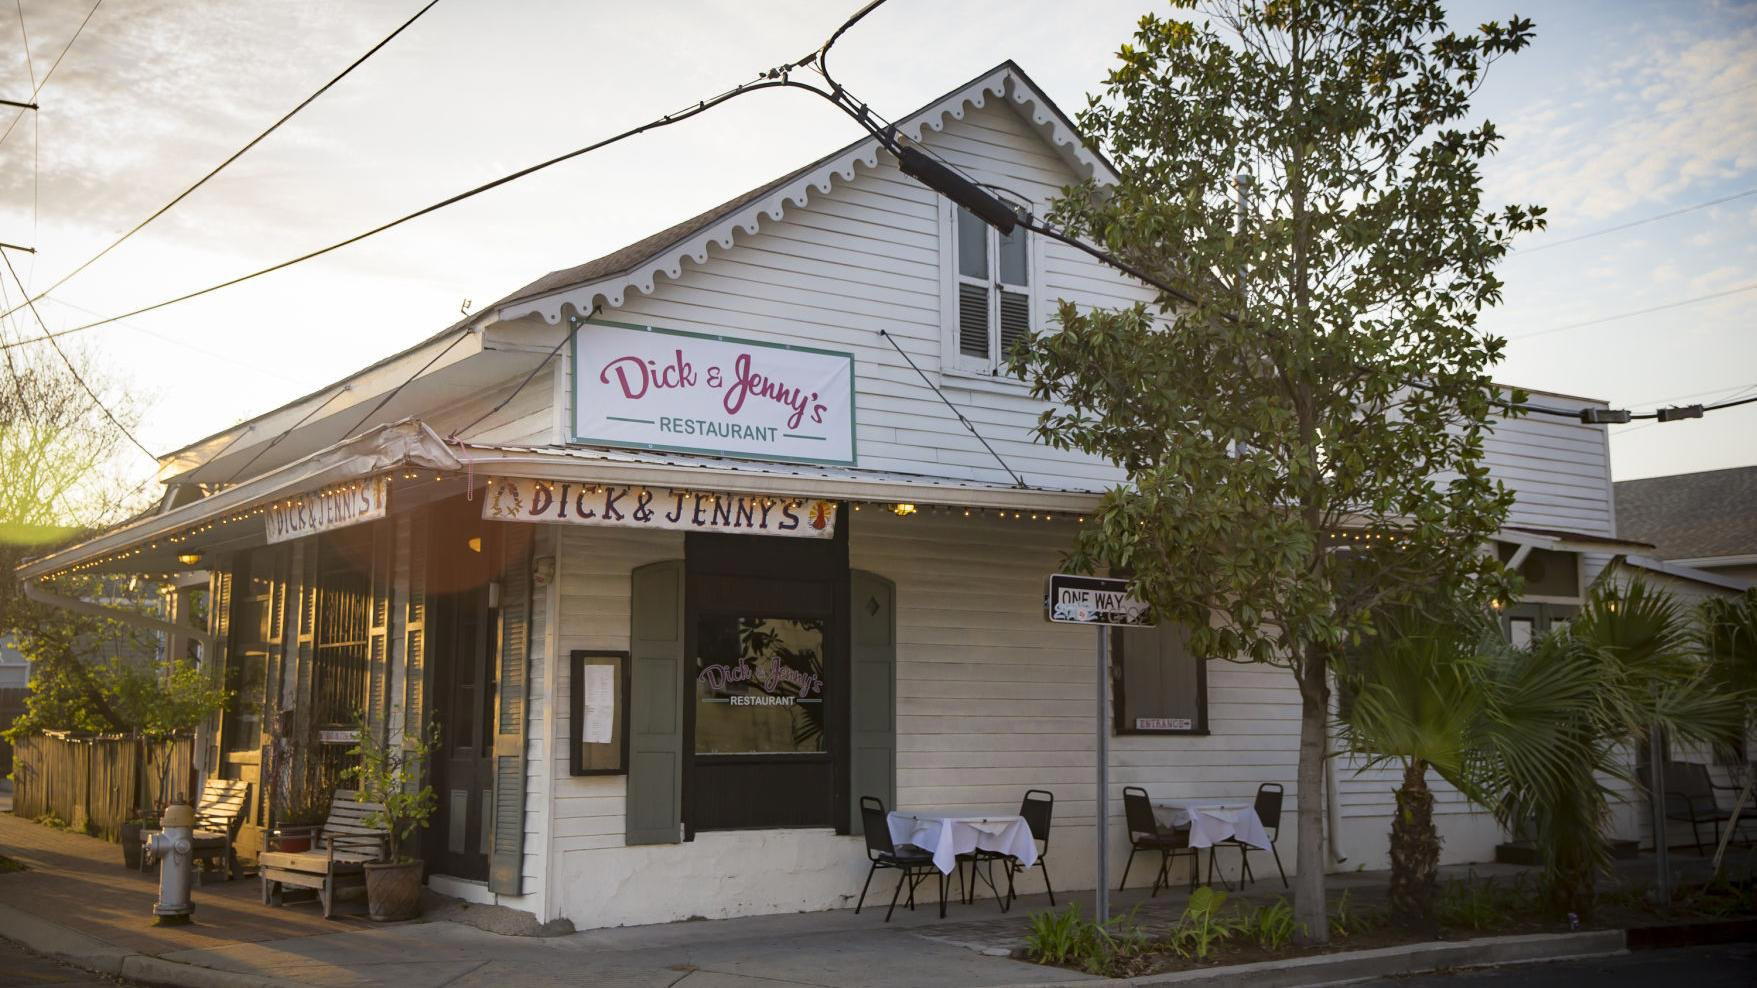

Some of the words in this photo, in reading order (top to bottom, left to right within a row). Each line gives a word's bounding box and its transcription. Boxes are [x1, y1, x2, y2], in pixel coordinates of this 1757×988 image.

[600, 349, 697, 399] Dick
[706, 366, 722, 388] &
[723, 353, 827, 430] Jenny's
[660, 416, 778, 442] RESTAURANT
[318, 480, 370, 526] JENNYS
[665, 491, 801, 530] JENNY'S
[1062, 590, 1090, 607] ONE
[1094, 592, 1125, 609] WAY
[697, 657, 752, 690] Dick
[764, 656, 823, 698] Jenny's
[730, 695, 796, 706] RESTAURANT
